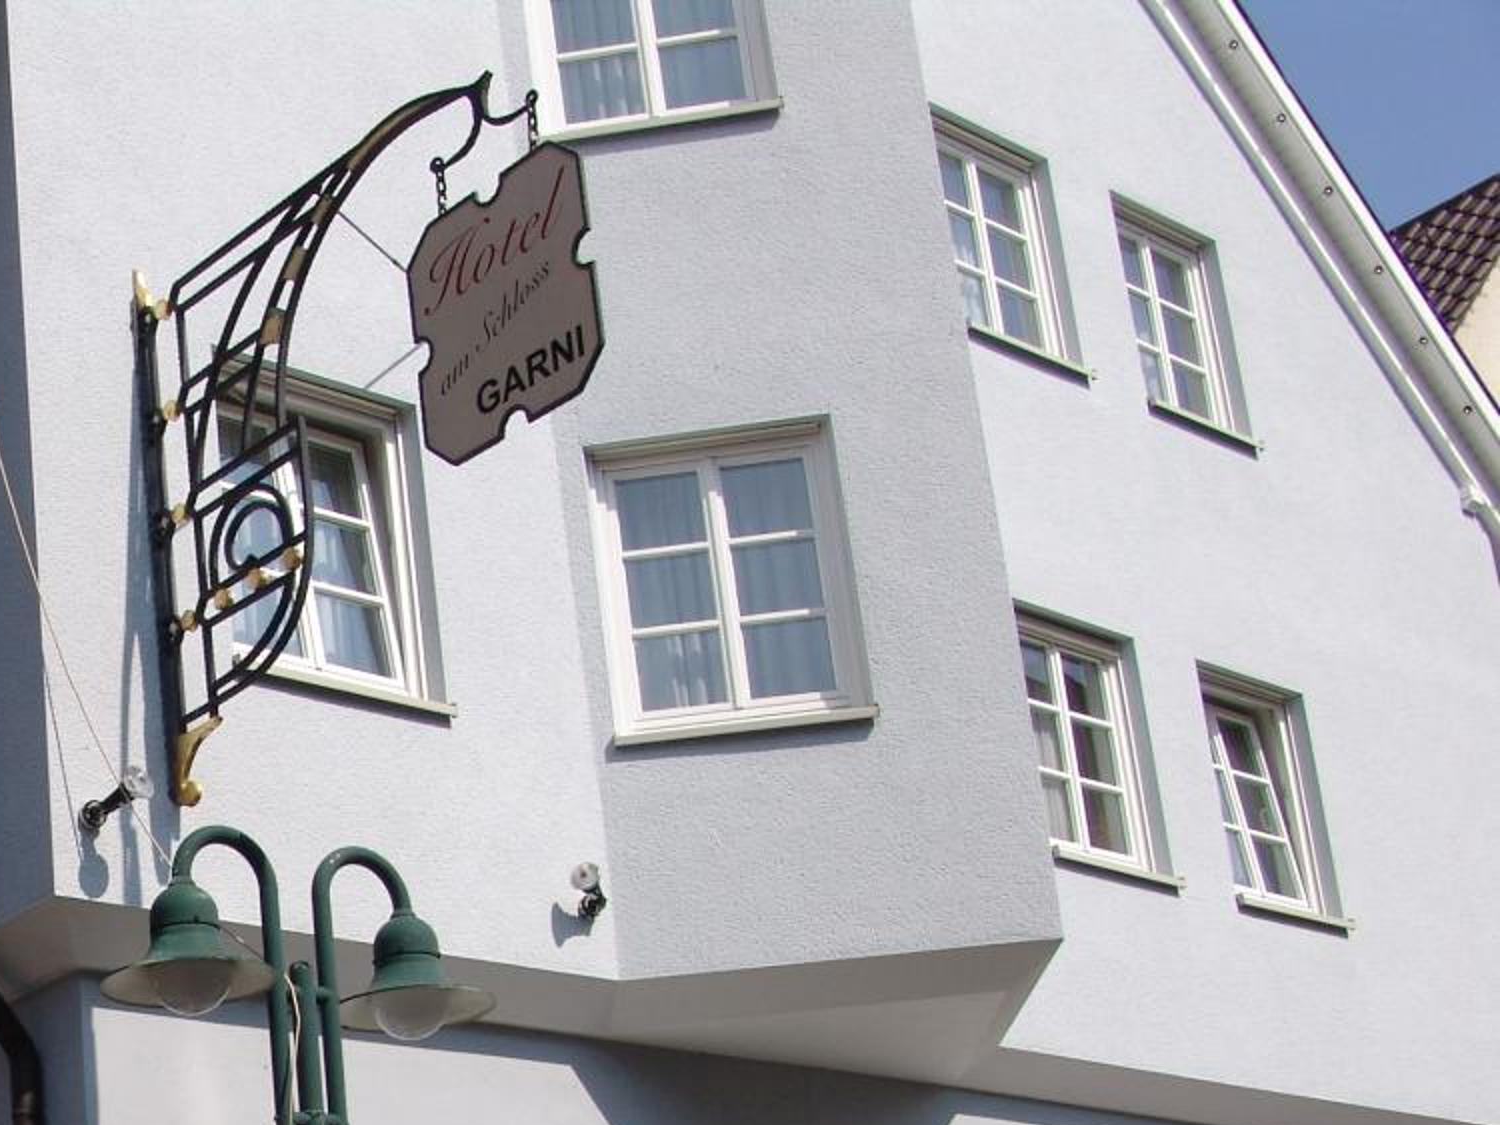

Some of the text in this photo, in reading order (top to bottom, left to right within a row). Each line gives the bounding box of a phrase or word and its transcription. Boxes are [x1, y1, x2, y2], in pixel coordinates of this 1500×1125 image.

[424, 165, 564, 316] Hotel
[440, 262, 549, 396] am Schloss
[476, 325, 585, 414] GARNI
